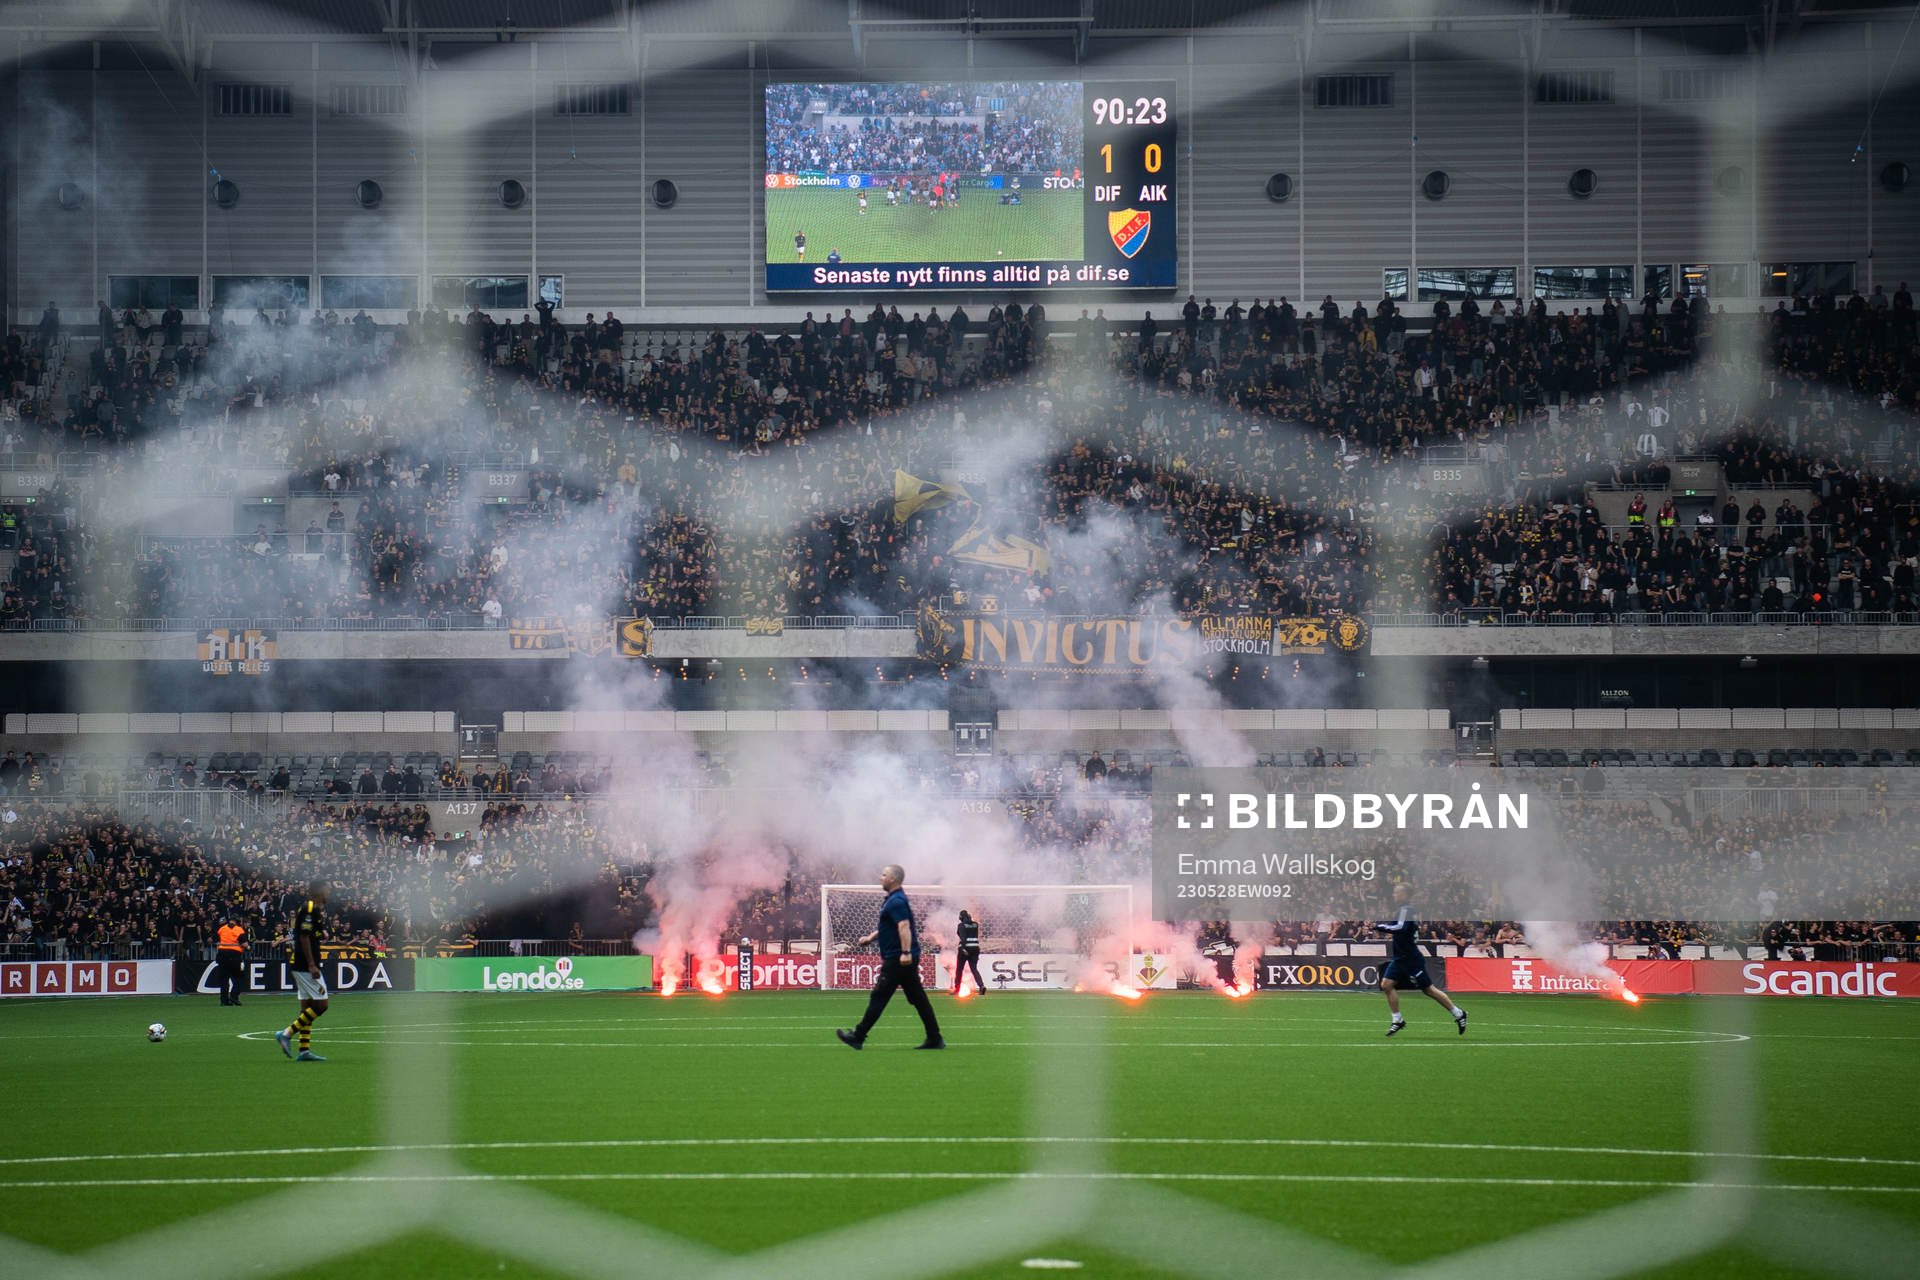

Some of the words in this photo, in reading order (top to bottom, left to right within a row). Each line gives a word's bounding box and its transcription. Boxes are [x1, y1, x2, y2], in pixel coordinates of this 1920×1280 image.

[1092, 97, 1167, 125] 90:23
[1100, 143, 1112, 174] 1
[1144, 143, 1162, 173] 0
[784, 175, 840, 186] Stockholm
[1095, 185, 1121, 202] DIF
[1139, 184, 1168, 201] AIK
[813, 267, 890, 284] Senaste
[896, 266, 933, 286] nytt
[938, 265, 987, 282] finns
[992, 264, 1040, 282] alltid
[1047, 264, 1070, 286] på
[1076, 264, 1130, 281] dif.se
[18, 476, 46, 487] B338
[489, 474, 517, 486] B337
[1433, 470, 1462, 481] B335
[206, 633, 268, 660] AIK
[962, 618, 1192, 666] INVICTUS
[1202, 638, 1270, 655] STOCKHOLM
[446, 803, 477, 815] A137
[961, 800, 991, 813] A136
[9, 968, 129, 988] RAMO
[250, 961, 393, 990] ELDA
[483, 965, 584, 989] Lendo.se
[702, 957, 827, 986] Proritet
[739, 951, 751, 990] SELECT
[1267, 965, 1379, 986] FXORO.C
[1742, 963, 1898, 995] Scandic
